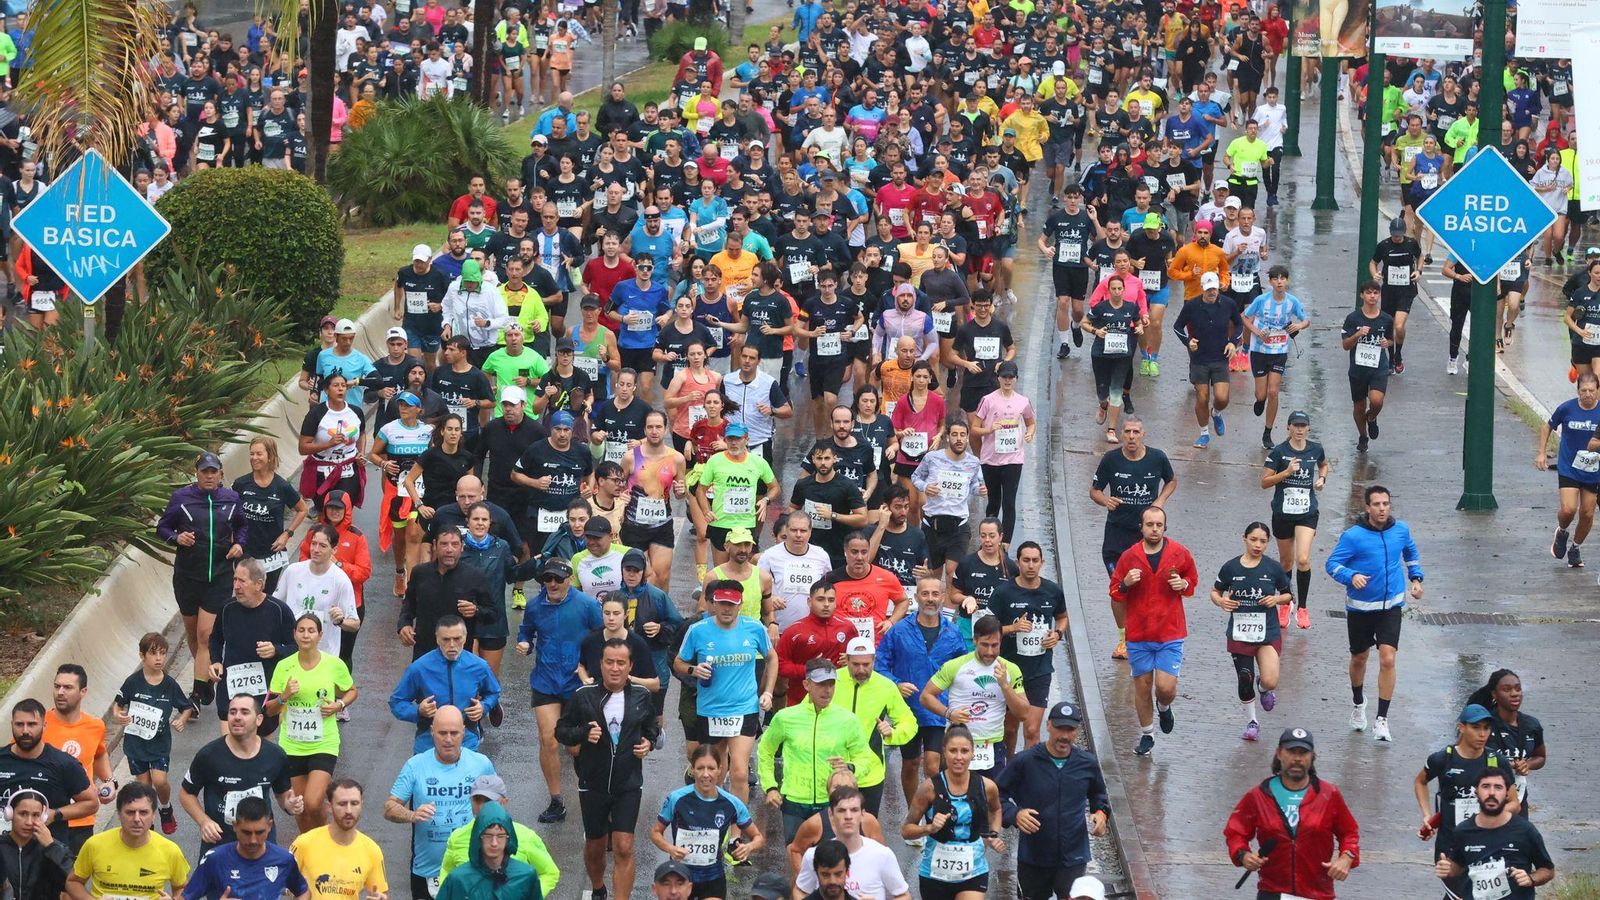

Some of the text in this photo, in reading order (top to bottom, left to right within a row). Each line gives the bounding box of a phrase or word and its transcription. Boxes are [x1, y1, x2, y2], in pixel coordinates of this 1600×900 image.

[1465, 194, 1509, 212] RED
[66, 204, 117, 223] RED
[1444, 211, 1528, 234] BÁSICA
[43, 227, 137, 248] BASICA
[821, 341, 839, 350] 5474
[1360, 352, 1377, 361] 1063
[941, 481, 963, 491] 5252
[729, 497, 750, 506] 1285
[640, 507, 666, 516] 10143
[543, 515, 565, 525] 5480
[591, 581, 614, 589] Unicaja
[790, 574, 813, 585] 6569
[1236, 623, 1264, 634] 12779
[230, 674, 264, 689] 12763
[971, 690, 997, 699] Unicaja
[131, 714, 157, 732] 12998
[291, 720, 318, 732] 7144
[711, 717, 741, 727] 11857
[970, 753, 989, 762] 295
[427, 783, 473, 799] nerja
[935, 858, 971, 872] 13731
[845, 880, 861, 892] SCA
[1476, 877, 1502, 891] 5010
